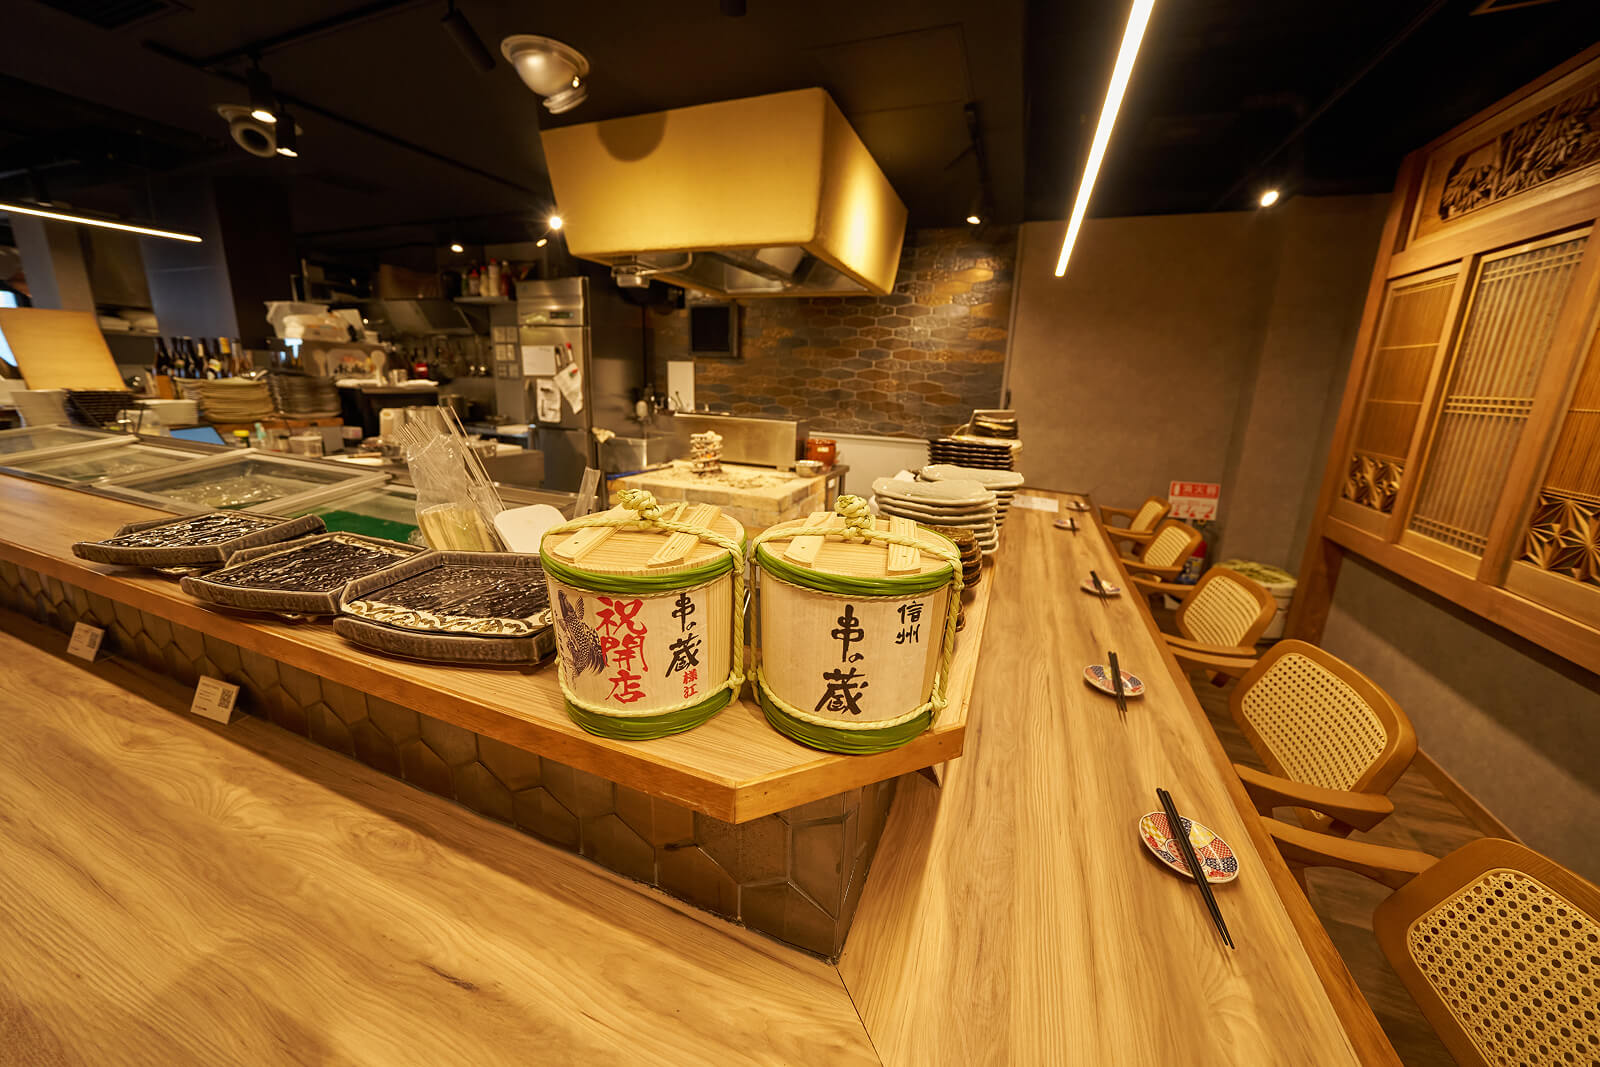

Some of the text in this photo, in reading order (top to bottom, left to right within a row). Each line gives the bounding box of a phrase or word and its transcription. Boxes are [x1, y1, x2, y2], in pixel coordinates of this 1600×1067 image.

[596, 597, 649, 704] 祝開店
[665, 593, 702, 678] 串の蔵
[814, 604, 869, 715] 串の蔵
[895, 600, 924, 645] 信州
